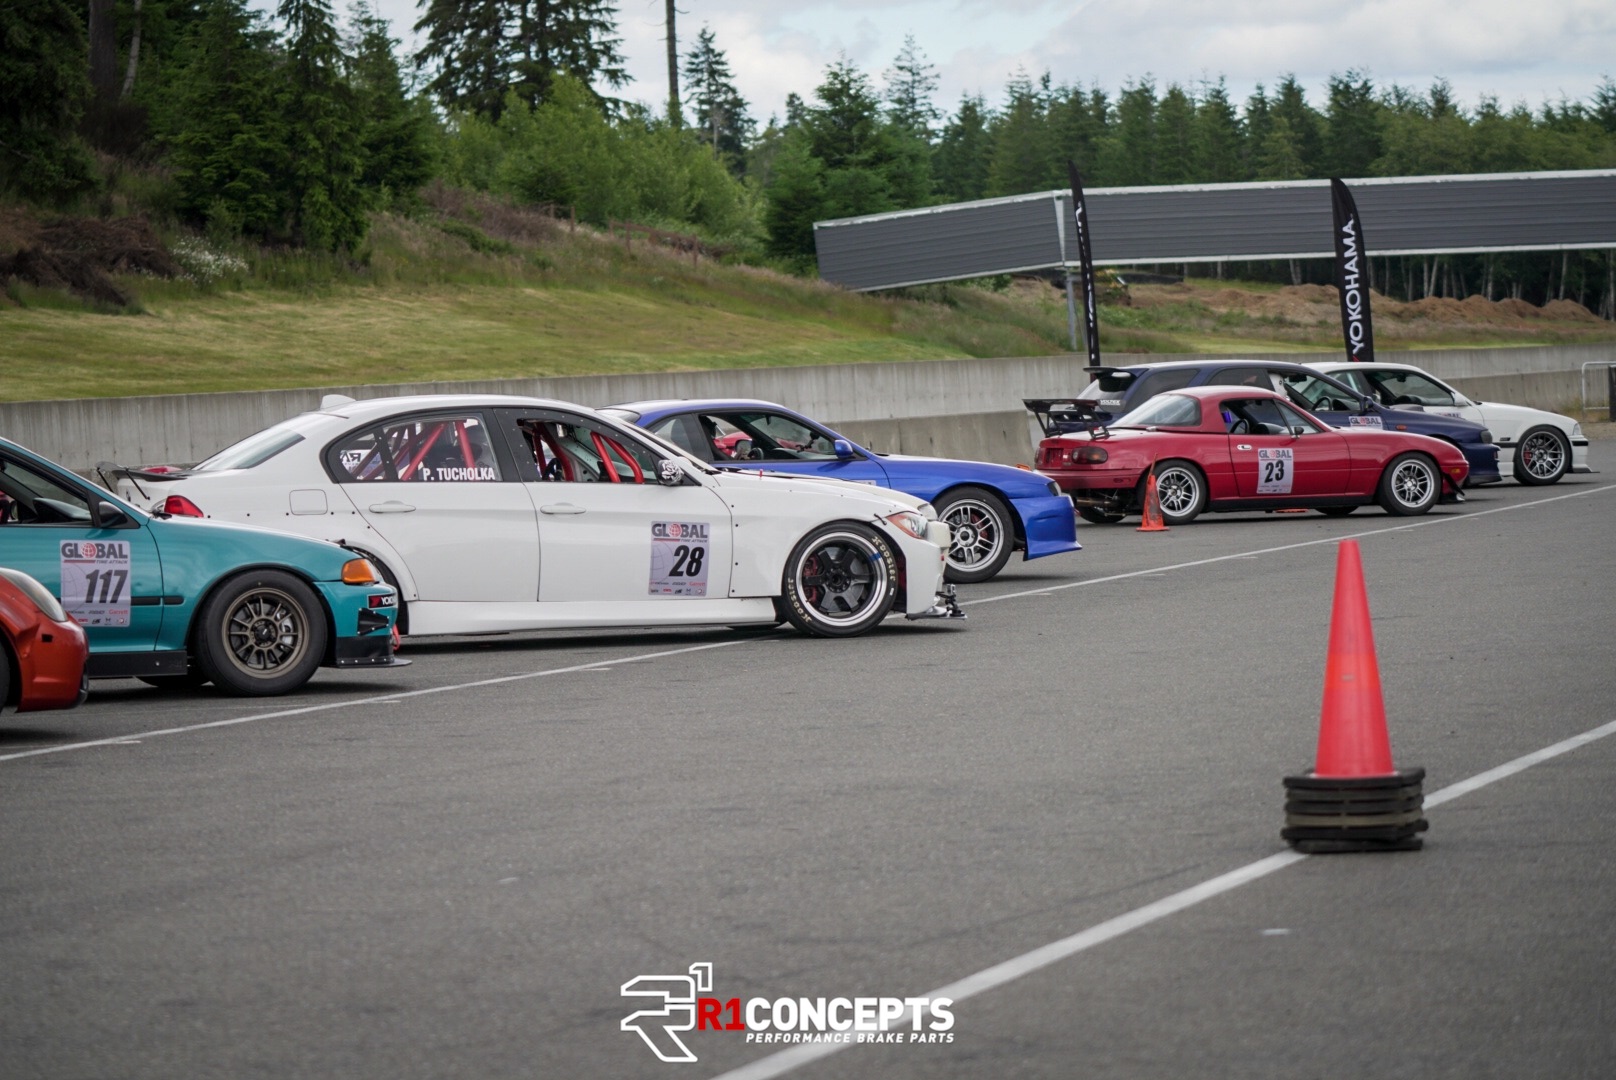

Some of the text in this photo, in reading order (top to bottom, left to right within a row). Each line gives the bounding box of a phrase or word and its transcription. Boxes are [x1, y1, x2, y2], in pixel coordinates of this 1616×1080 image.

[1342, 217, 1365, 354] YOKOHAMA
[423, 468, 495, 480] P. TUCHOLKA
[1264, 460, 1285, 483] 23
[668, 545, 705, 577] 28
[85, 569, 128, 604] 117
